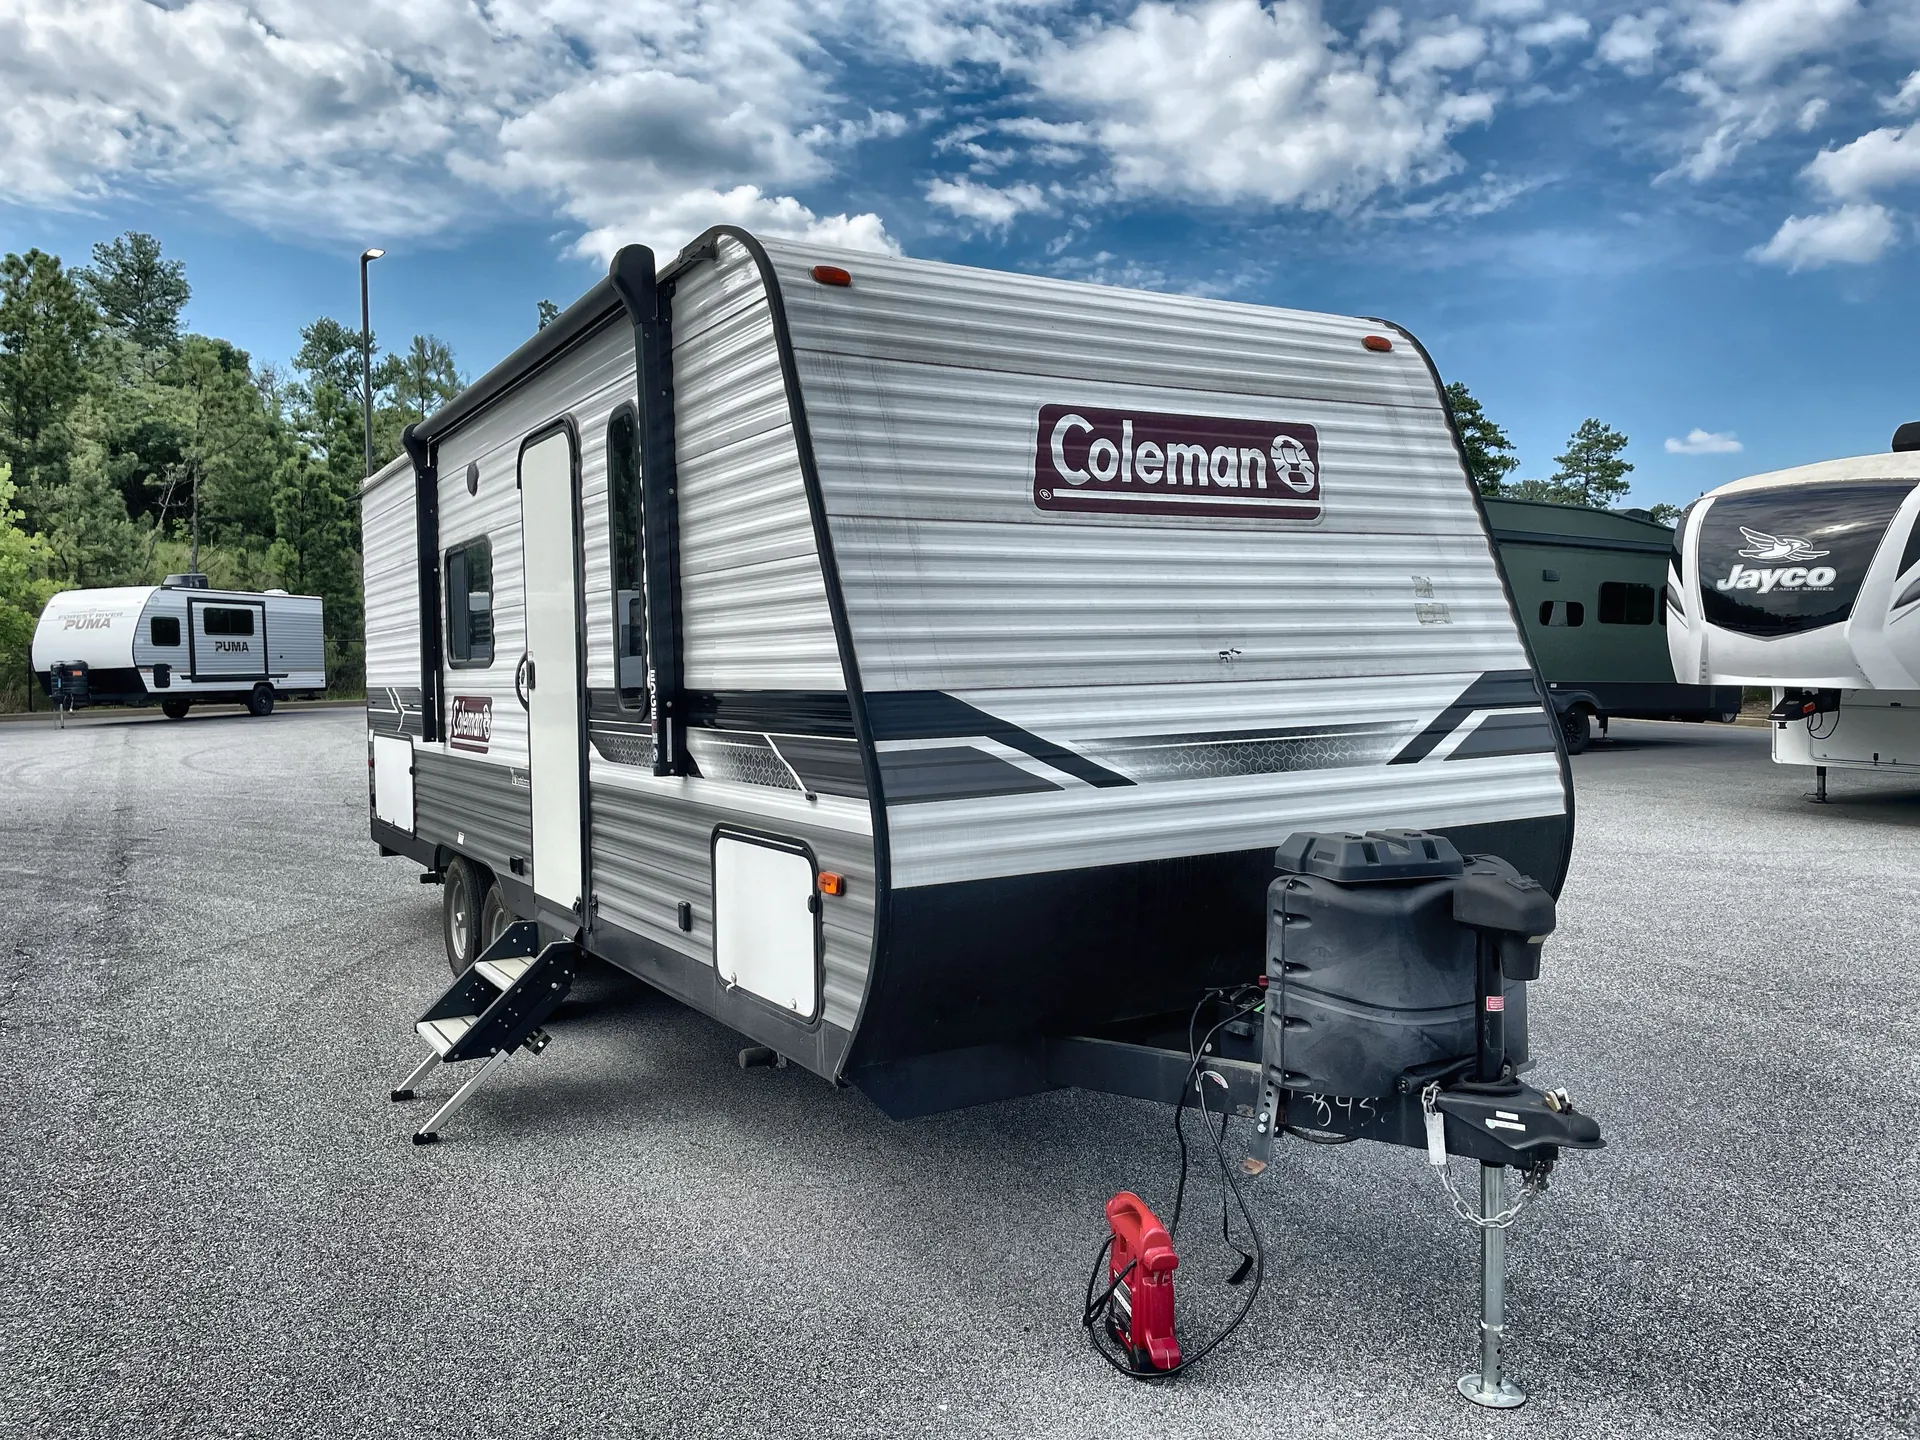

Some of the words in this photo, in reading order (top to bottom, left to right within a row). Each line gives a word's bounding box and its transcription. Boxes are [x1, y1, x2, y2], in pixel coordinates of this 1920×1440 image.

[1050, 413, 1268, 489] Coleman
[1716, 564, 1837, 594] Jayco
[63, 618, 111, 631] PUMA
[215, 641, 249, 652] PUMA
[453, 699, 483, 737] Coleman
